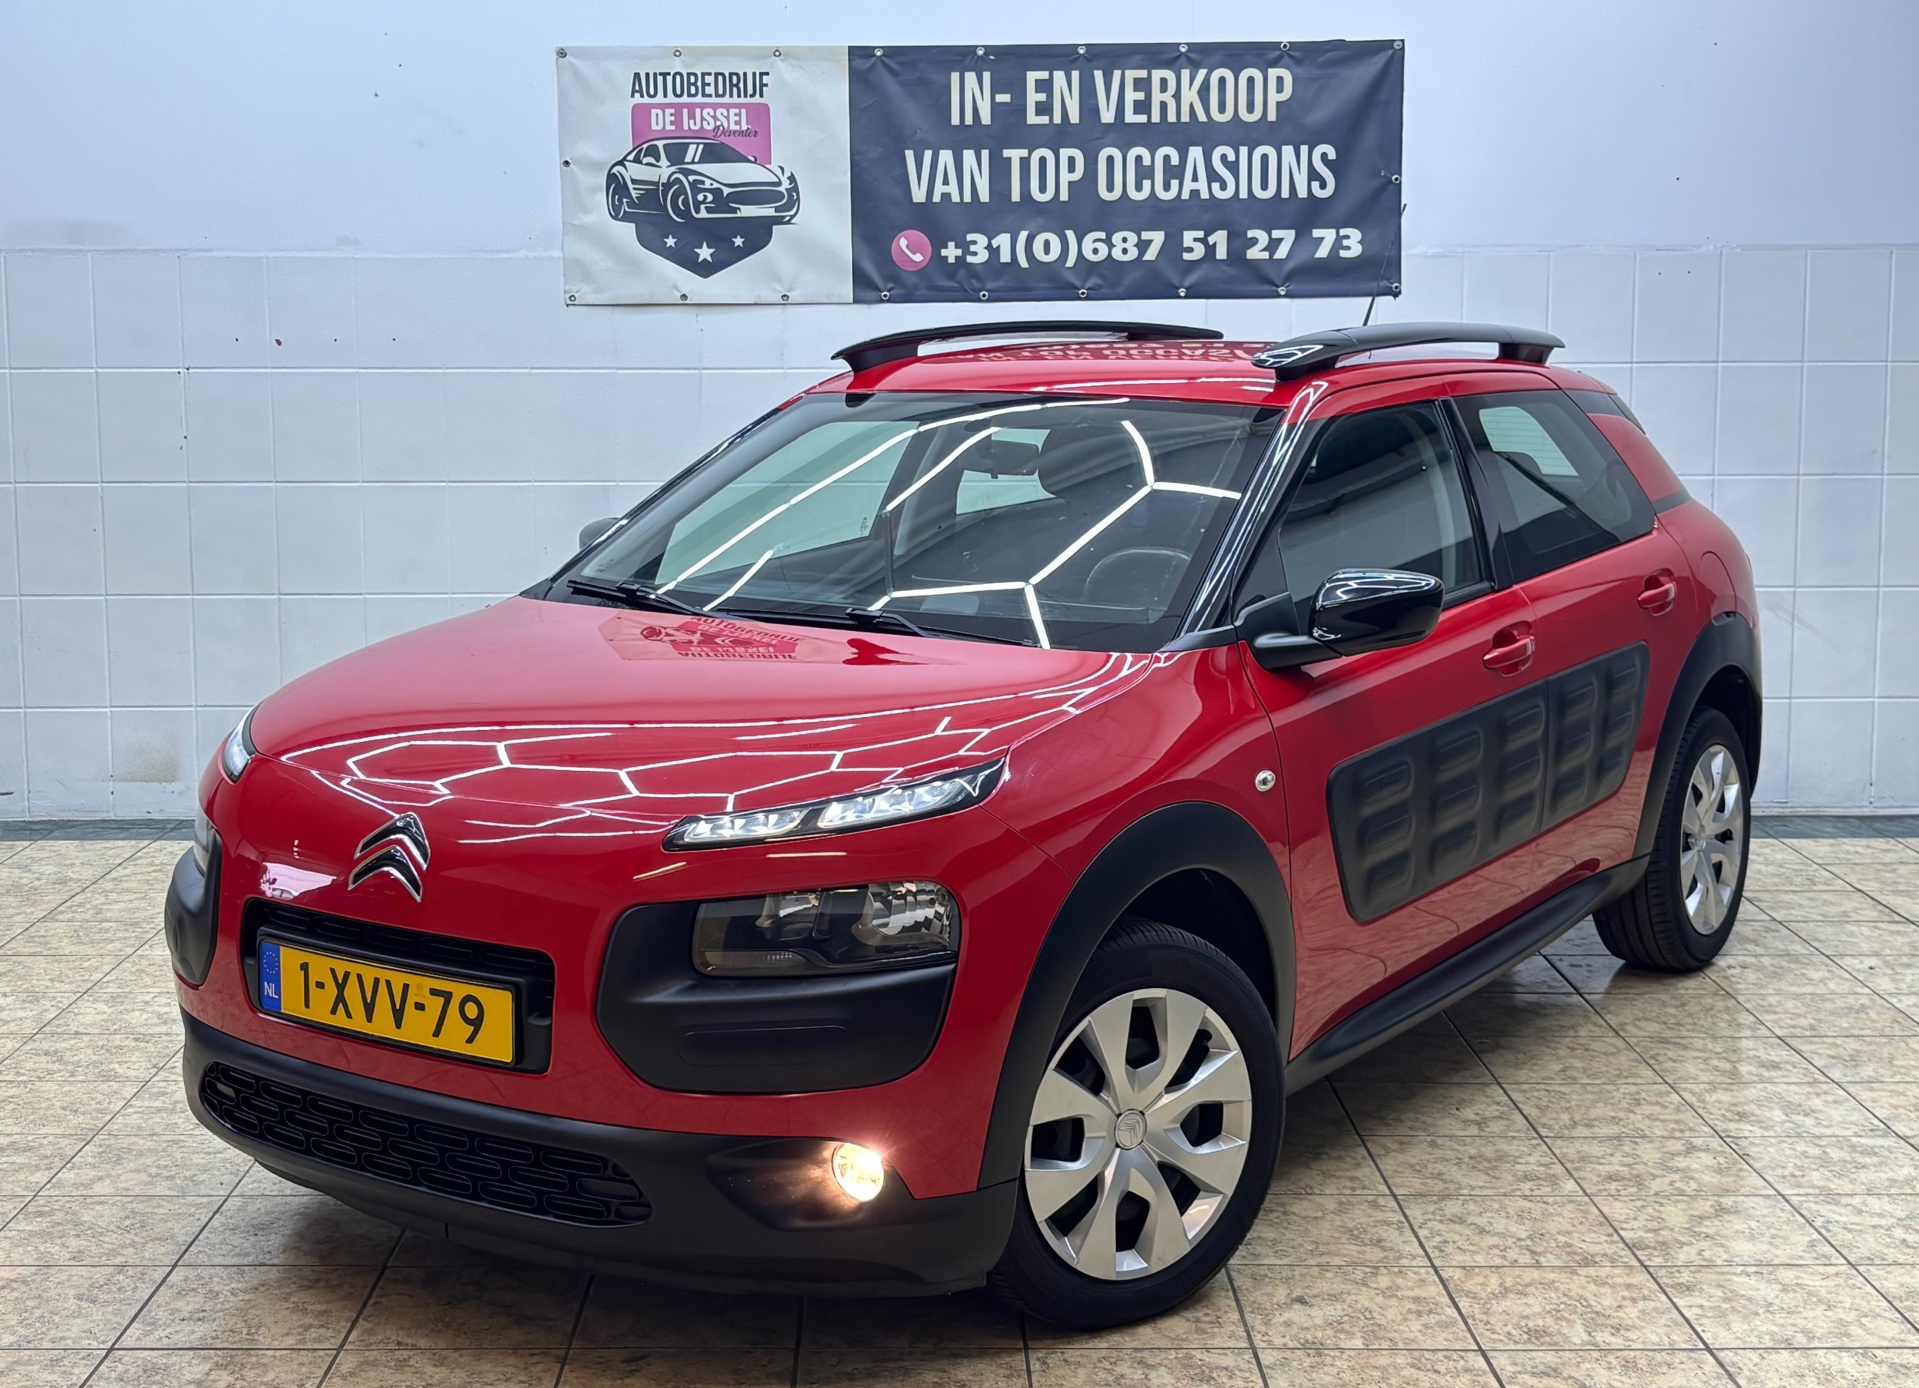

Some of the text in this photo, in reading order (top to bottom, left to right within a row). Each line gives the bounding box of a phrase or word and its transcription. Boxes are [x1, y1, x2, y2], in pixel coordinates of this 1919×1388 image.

[630, 71, 770, 99] AUTOBEDRIJF
[950, 67, 1294, 126] IN- EN VERKOOP
[650, 107, 752, 131] DE IJSSEL
[712, 124, 759, 139] Deventer
[904, 143, 1338, 203] VAN TOP OCCASIONS
[940, 227, 1364, 268] +31(0)687 51 27 73
[264, 981, 280, 999] NL
[299, 961, 486, 1045] 1-XVV-79
